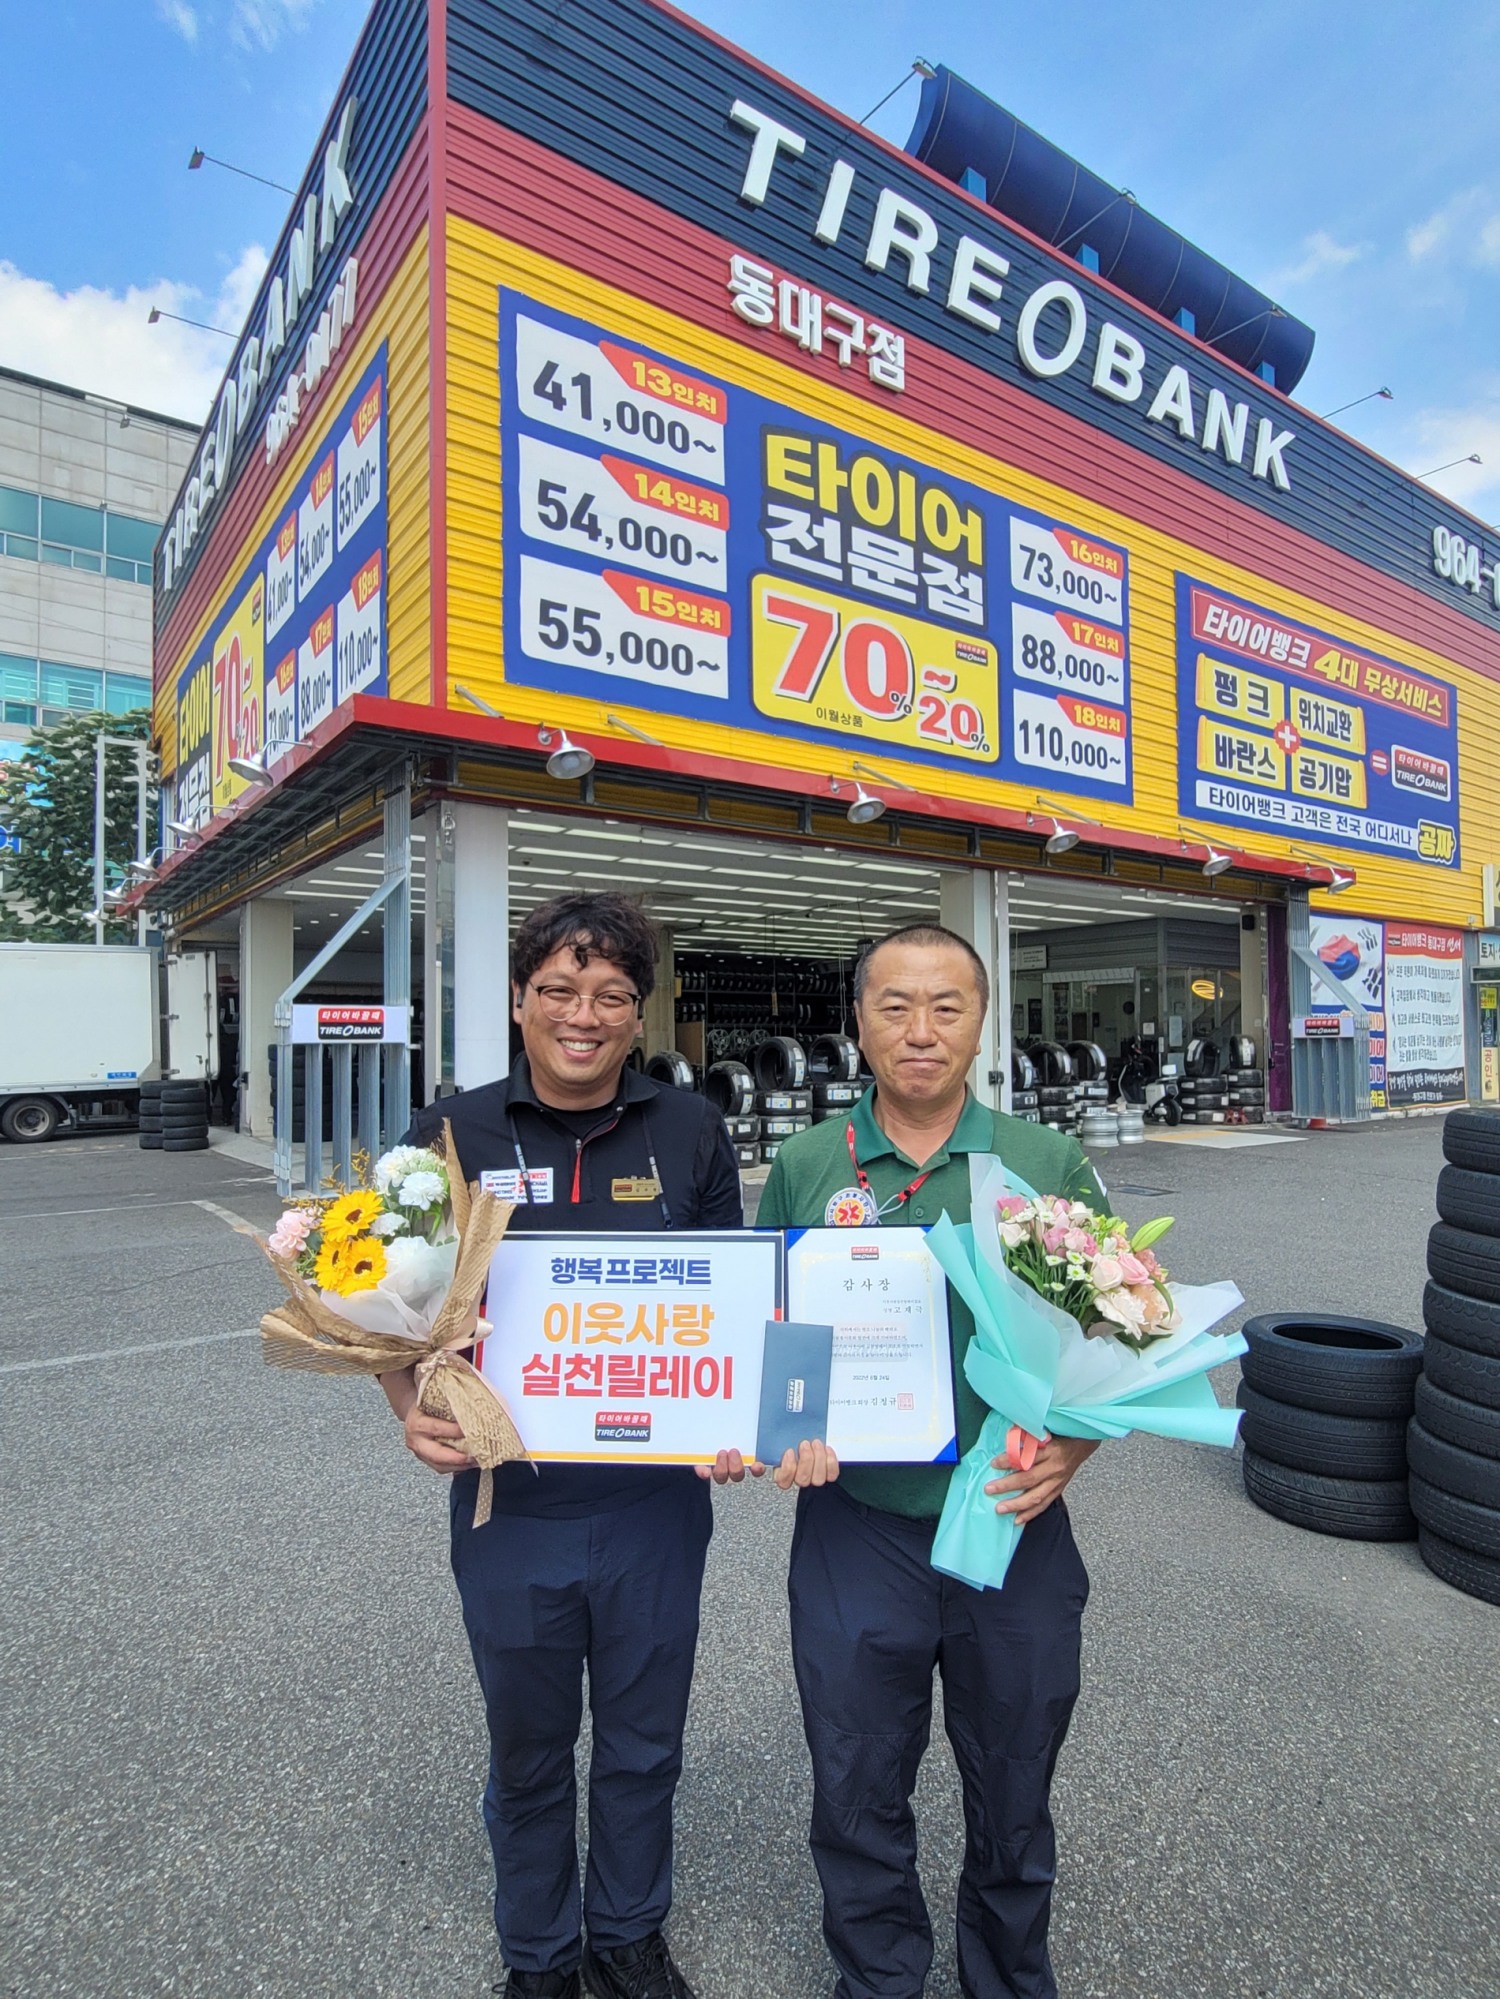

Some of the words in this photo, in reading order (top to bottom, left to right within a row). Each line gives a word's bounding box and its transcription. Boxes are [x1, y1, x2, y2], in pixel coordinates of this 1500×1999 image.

[729, 98, 1296, 491] TIREOBANK
[727, 254, 906, 392] 동대구점
[533, 360, 717, 454] 41,000~
[632, 361, 717, 415] 13인치
[537, 478, 719, 567] 54,000~
[635, 473, 719, 522] 14인치
[767, 434, 983, 566] 타이어
[765, 503, 984, 627] 전문점
[1018, 543, 1118, 604] 73,000~
[1069, 539, 1118, 574] 16인치
[635, 585, 721, 629] 15인치
[537, 597, 721, 676] 55,000~
[1021, 633, 1120, 687] 88,000~
[1072, 621, 1119, 654] 17인치
[1202, 603, 1311, 669] 타이어뱅크
[1315, 649, 1359, 689] 4대
[1364, 669, 1443, 718] 무상서비스
[179, 662, 210, 766] 타이어
[815, 706, 863, 729] 이월상품
[1073, 704, 1121, 733] 18인치
[1298, 697, 1352, 742] 위치교환
[1019, 719, 1122, 769] 110,000~
[1214, 733, 1276, 780] 바란스
[1299, 757, 1352, 797] 공기압
[1209, 786, 1286, 820] 타이어뱅크
[1291, 804, 1332, 829] 고객은
[1336, 816, 1361, 837] 전국
[1365, 820, 1412, 846] 어디서나
[1418, 824, 1454, 860] 공짜
[543, 1301, 715, 1346] 이웃사랑
[521, 1353, 733, 1400] 실천릴레이
